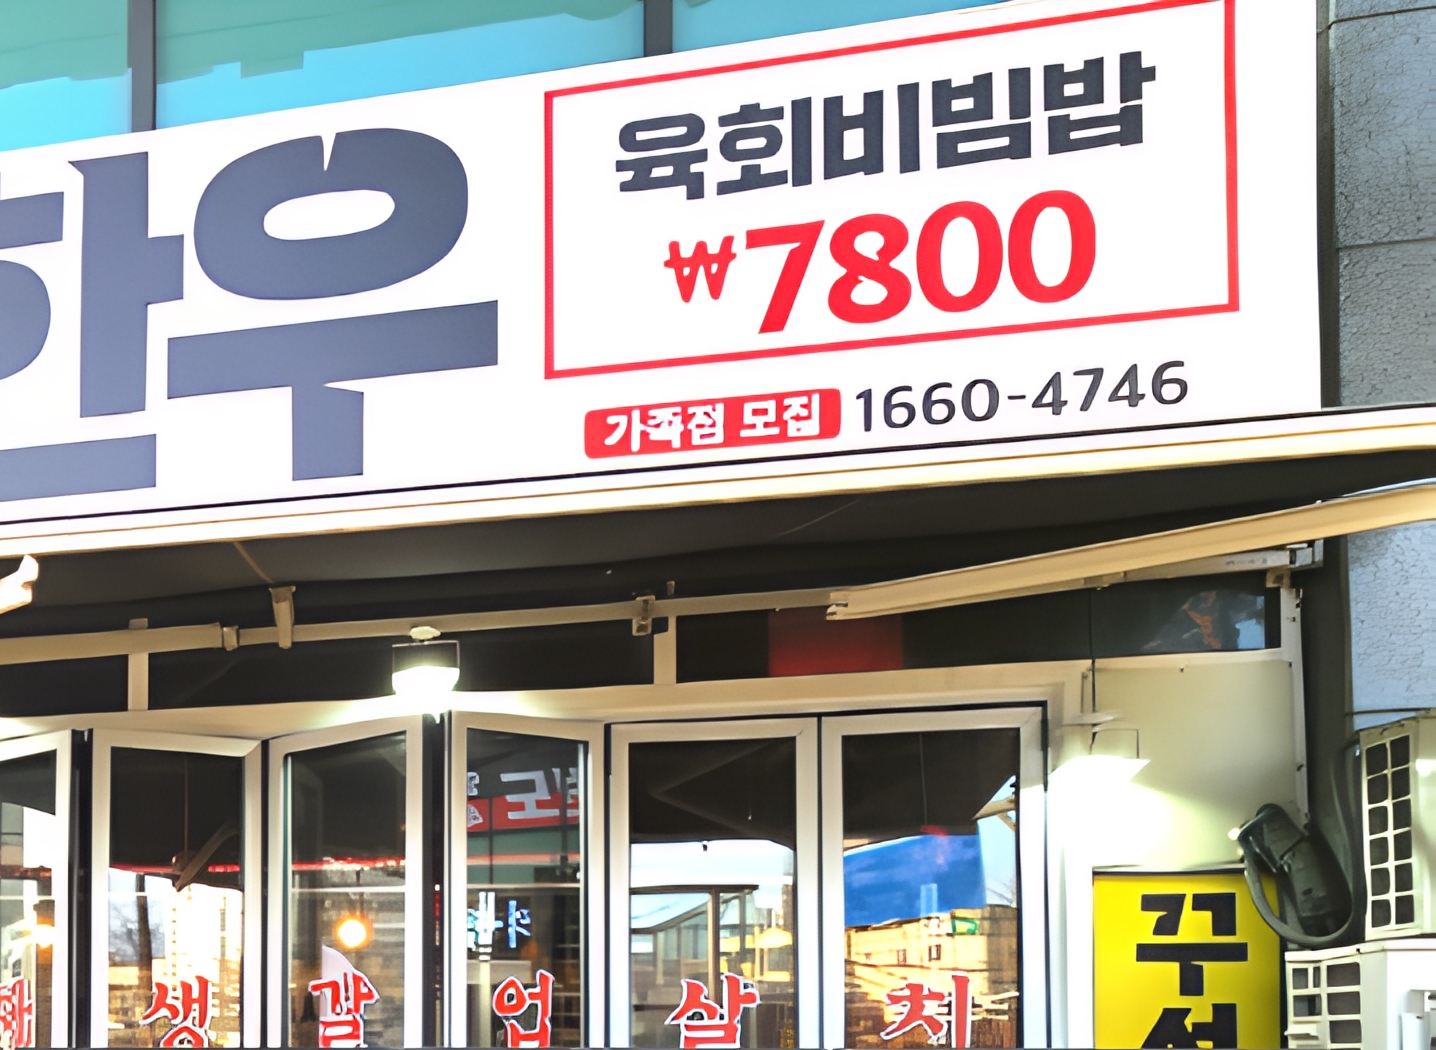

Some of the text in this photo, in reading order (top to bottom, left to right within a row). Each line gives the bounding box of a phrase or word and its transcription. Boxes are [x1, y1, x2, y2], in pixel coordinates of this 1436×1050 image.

[615, 51, 1156, 200] 육회비빔밥
[740, 393, 820, 437] 모집
[856, 360, 1189, 433] 1660-4746
